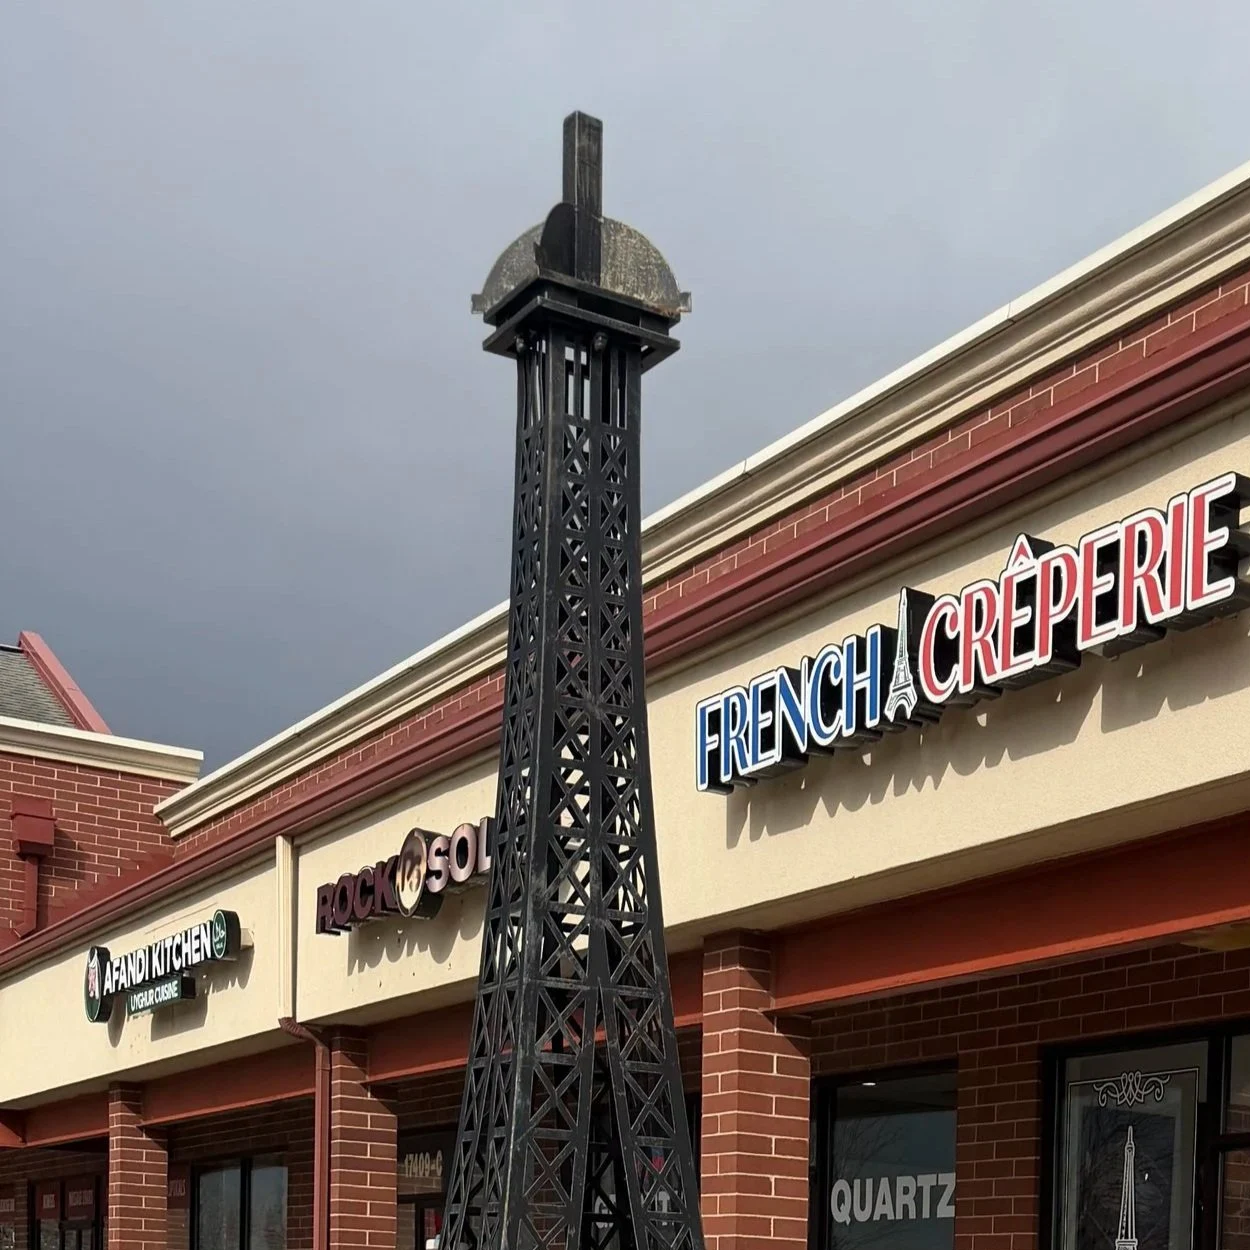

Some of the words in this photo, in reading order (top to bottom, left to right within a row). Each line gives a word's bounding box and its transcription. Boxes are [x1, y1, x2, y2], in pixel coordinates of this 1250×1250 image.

[696, 624, 880, 793] FRENCH
[919, 471, 1238, 703] CRÊPERIE
[316, 855, 399, 935] ROCK
[103, 946, 149, 996] AFANDI
[152, 921, 211, 979] KITCHEN
[130, 989, 154, 1011] UYGHUR
[154, 980, 178, 1003] CUISINE
[405, 1150, 442, 1178] 17409-C
[831, 1172, 956, 1226] QUARTZ
